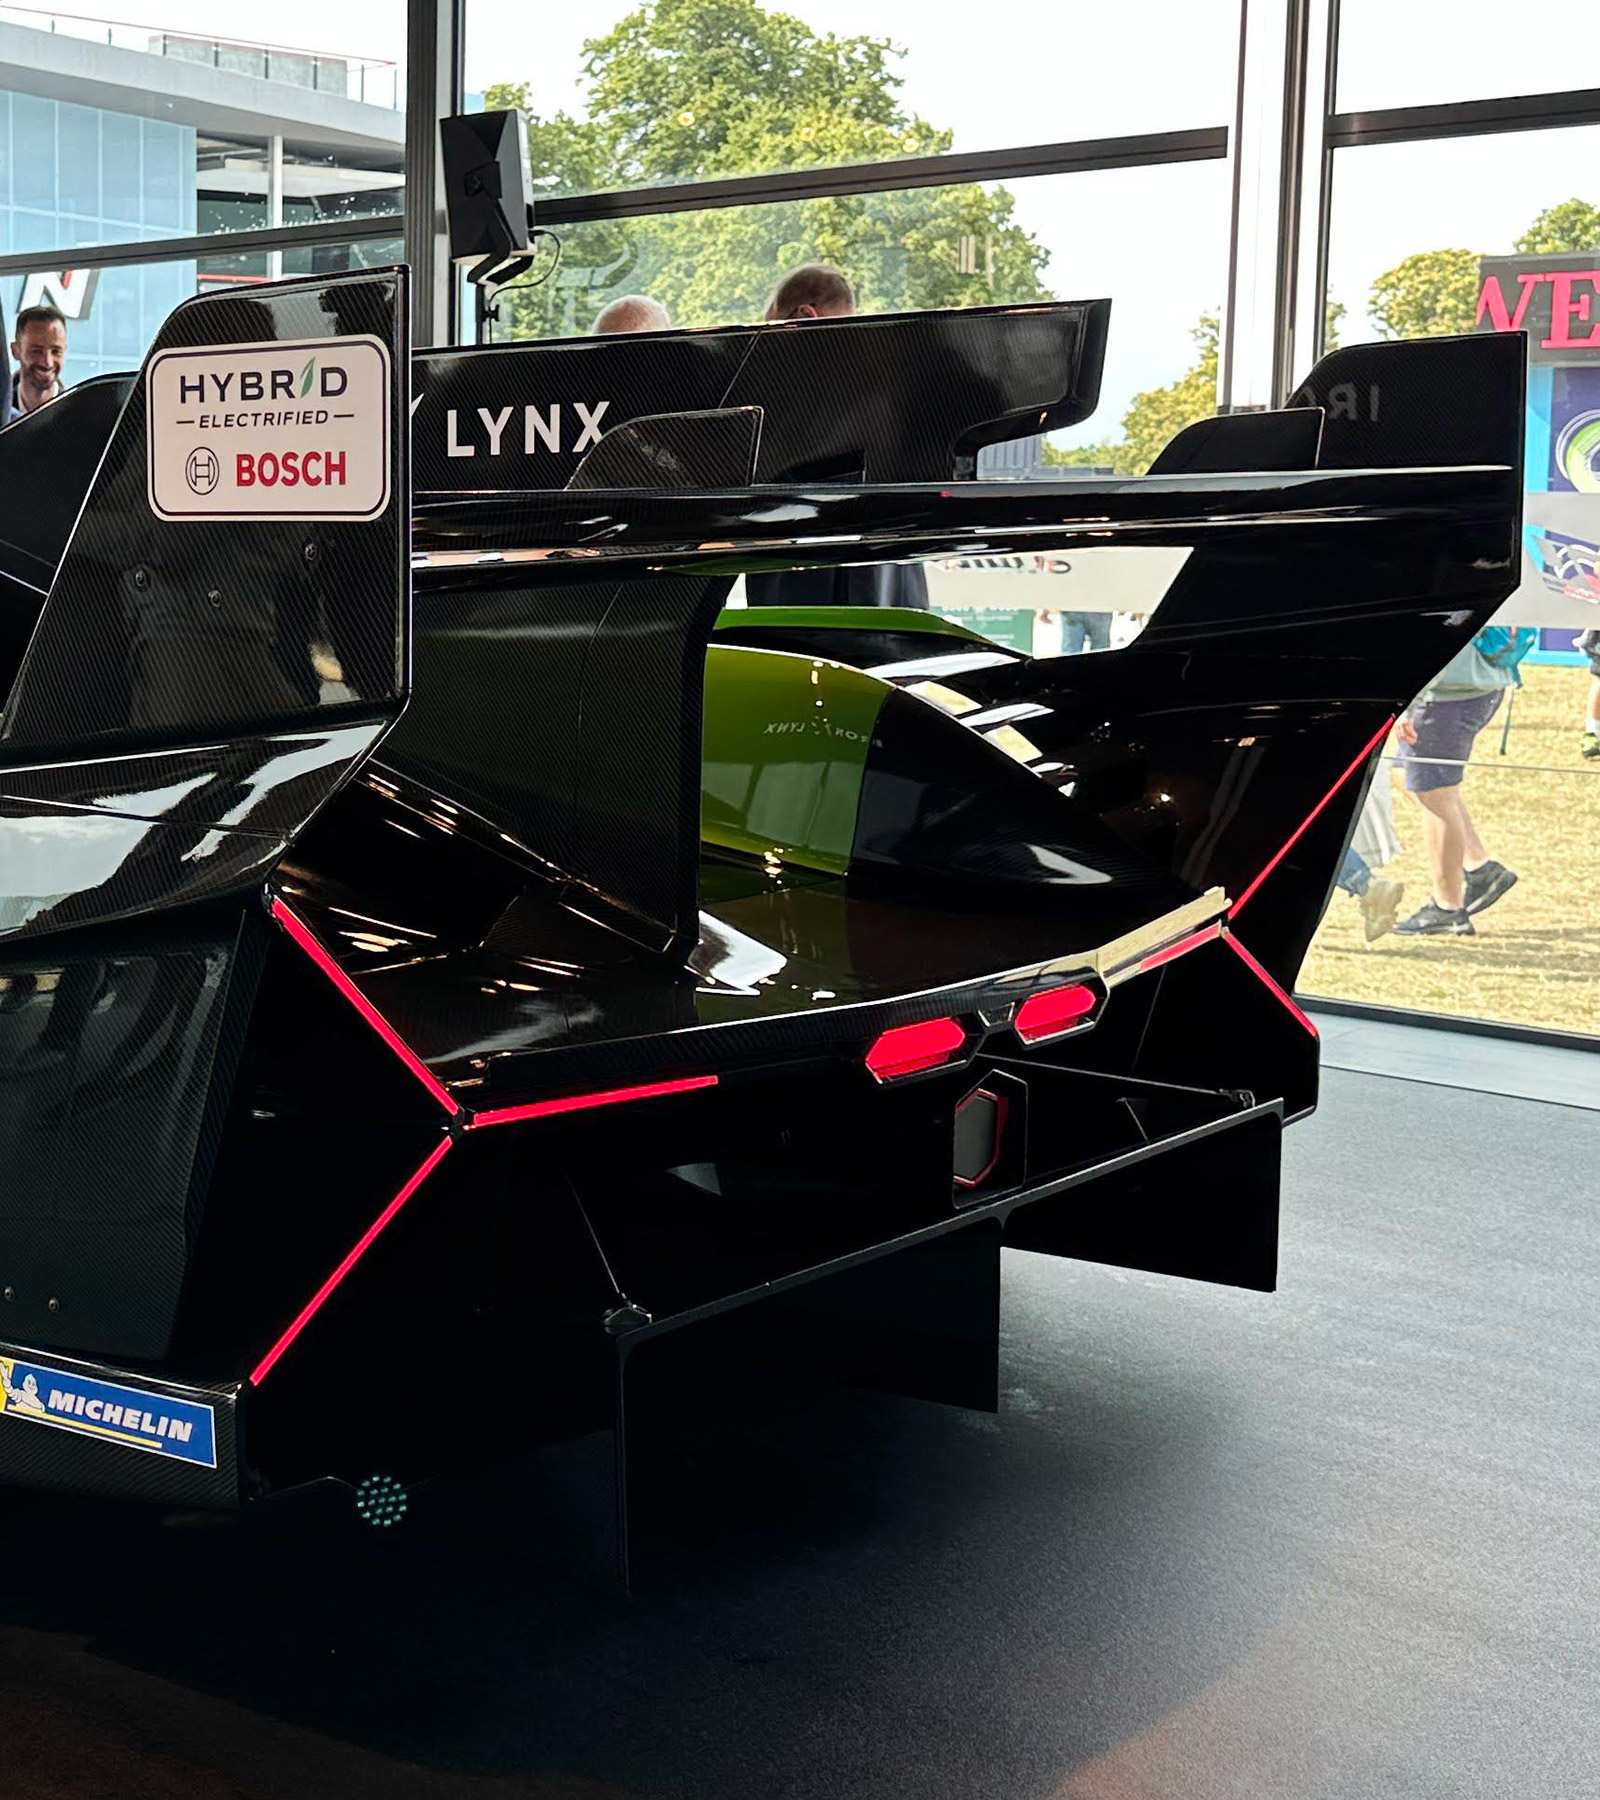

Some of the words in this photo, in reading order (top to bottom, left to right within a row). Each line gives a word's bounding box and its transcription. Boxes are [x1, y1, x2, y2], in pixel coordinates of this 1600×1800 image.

[180, 357, 348, 404] HYBRID
[199, 410, 329, 429] ELECTRIFIED
[447, 401, 610, 457] LYNX
[236, 451, 347, 487] BOSCH
[48, 1388, 193, 1444] MICHELIN
